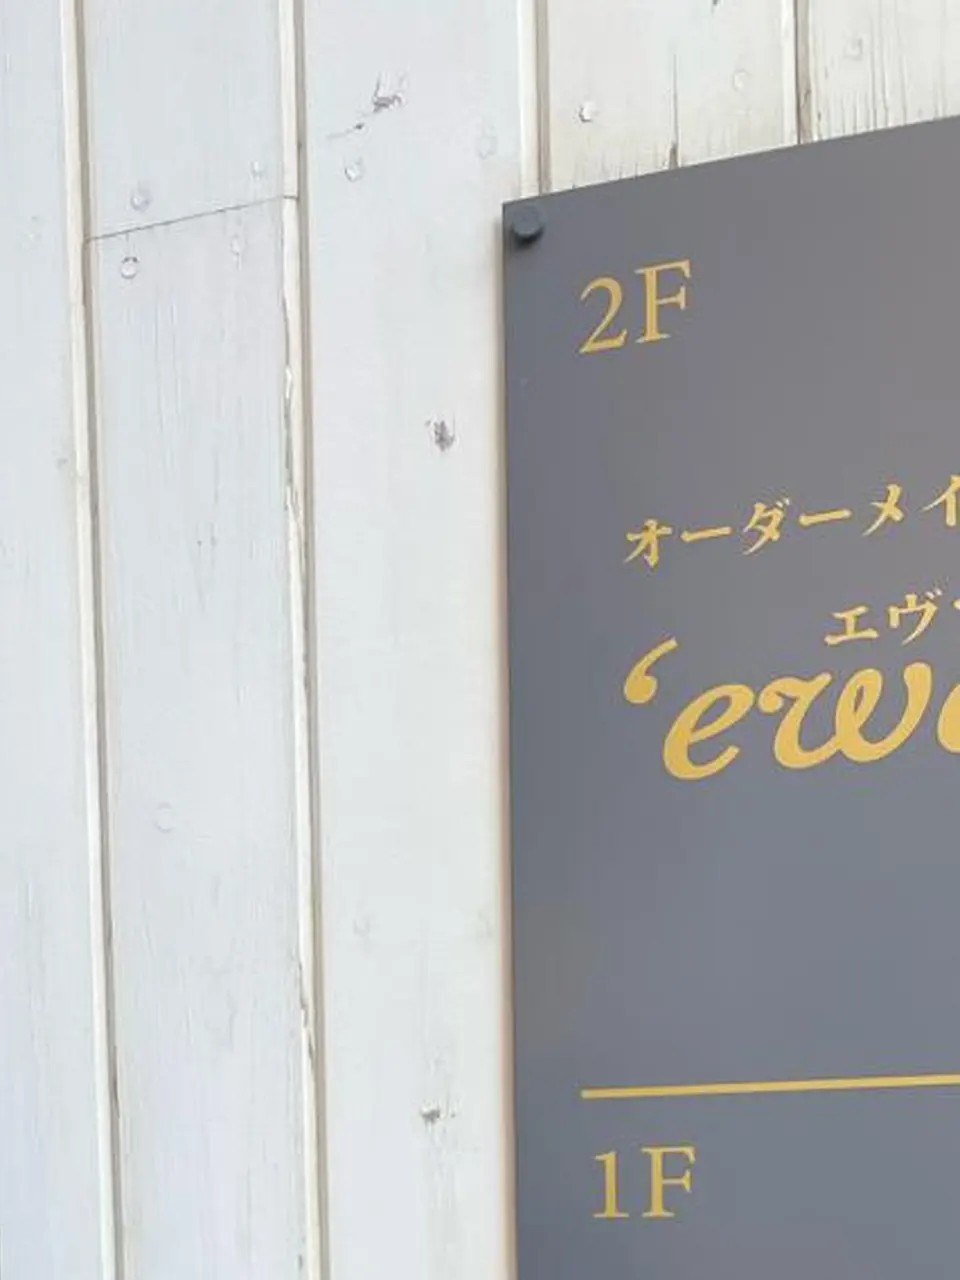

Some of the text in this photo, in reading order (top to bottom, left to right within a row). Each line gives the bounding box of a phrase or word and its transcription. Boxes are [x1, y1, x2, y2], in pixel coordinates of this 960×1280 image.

[579, 260, 693, 355] 2F
[824, 587, 960, 646] エヴ
[593, 1144, 697, 1220] 1F
